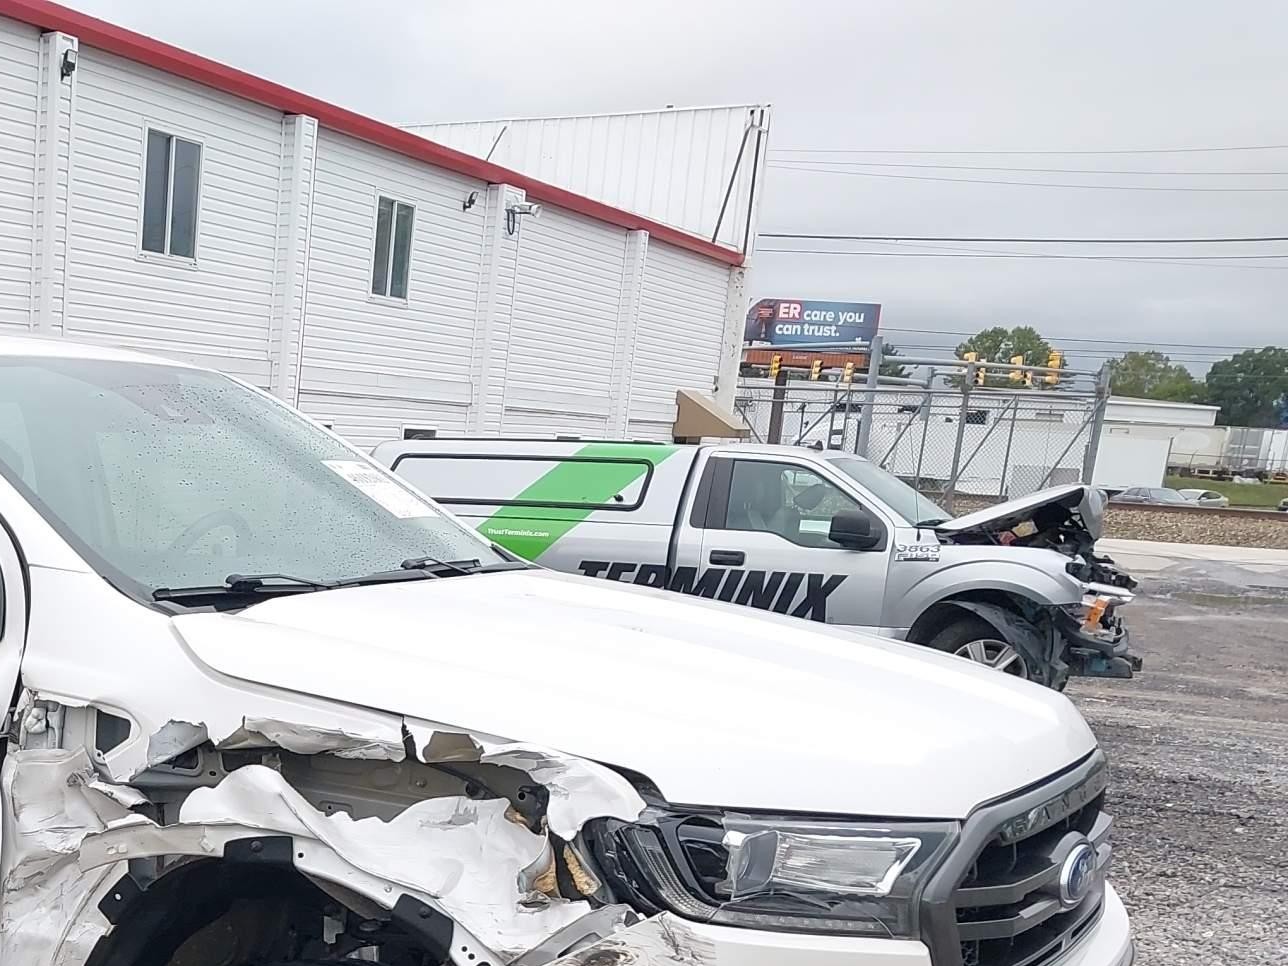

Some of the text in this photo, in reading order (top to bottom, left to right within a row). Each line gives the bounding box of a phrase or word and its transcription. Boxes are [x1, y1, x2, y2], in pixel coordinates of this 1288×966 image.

[778, 303, 865, 325] ER care you
[775, 322, 840, 337] can trust.
[487, 528, 550, 537] TrustTerminix.com
